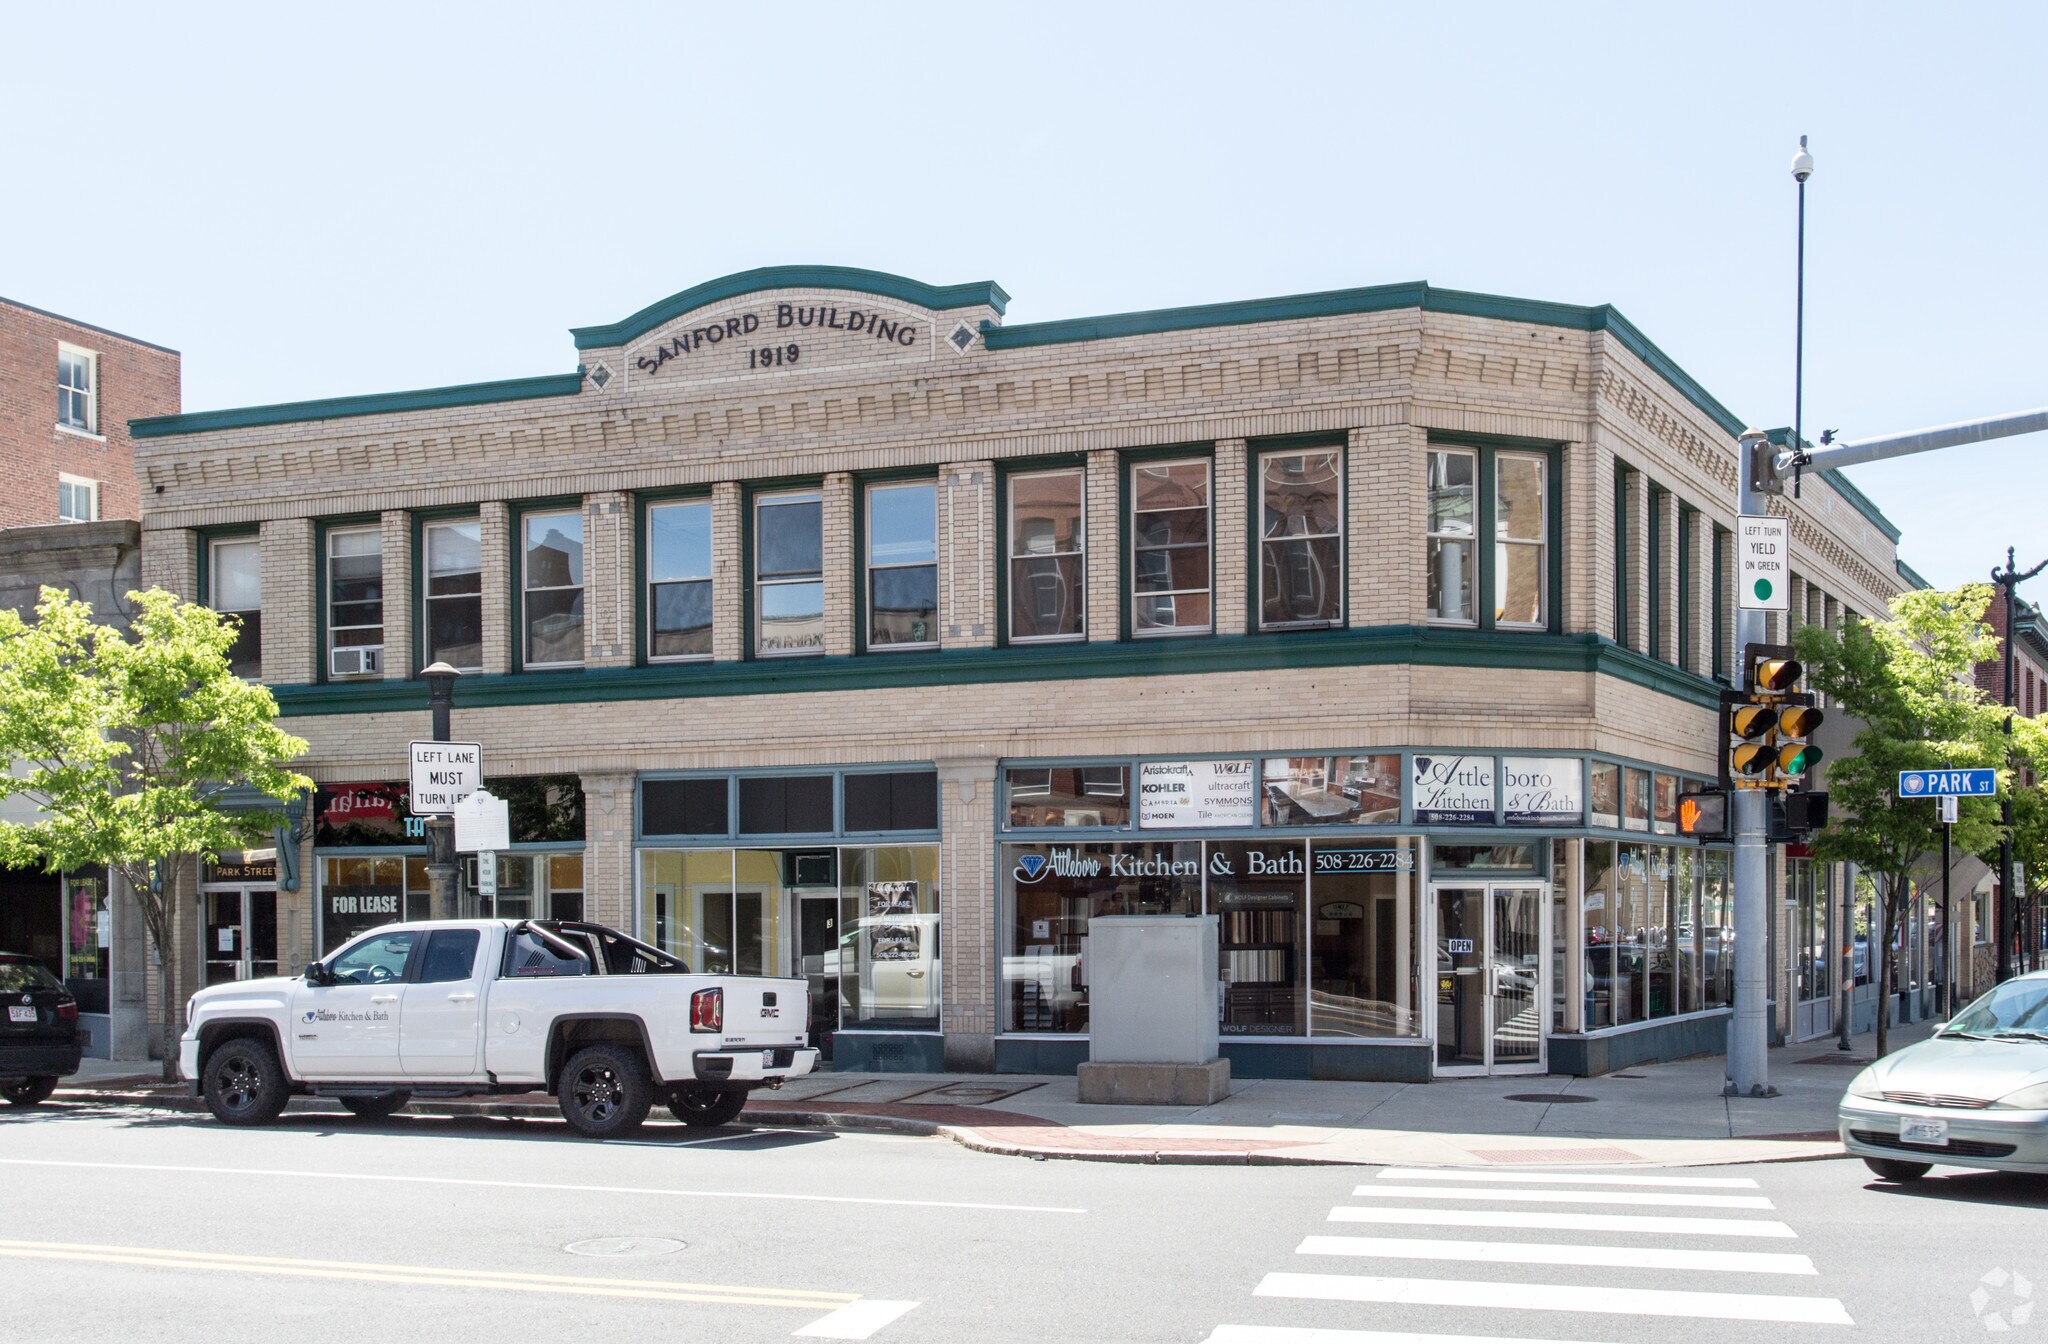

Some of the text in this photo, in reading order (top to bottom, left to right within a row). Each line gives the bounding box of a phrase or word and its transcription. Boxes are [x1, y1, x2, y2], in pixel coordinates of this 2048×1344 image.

[637, 304, 916, 375] SANFORD BUILDING
[749, 343, 799, 369] 1919
[1745, 526, 1782, 536] LEFT TURN
[1751, 542, 1776, 555] YIELD
[1745, 560, 1780, 570] ON GREEN
[417, 751, 475, 763] LEFT LANE
[1142, 764, 1188, 775] Aristokraft
[1213, 762, 1252, 775] WOLF
[430, 771, 463, 785] MUST
[1928, 773, 1990, 792] PARK ST
[1141, 783, 1186, 793] KOHLER
[1208, 780, 1251, 791] ultracraft
[419, 793, 470, 805] TURN LEF
[1204, 796, 1253, 805] SYMMONS
[1418, 786, 1490, 809] Kitchen
[1527, 788, 1574, 812] Bath
[1151, 812, 1175, 820] MOEN
[1197, 810, 1213, 819] Tile
[1431, 813, 1474, 821] 508-226-2284
[404, 816, 425, 837] TA
[1040, 848, 1304, 878] Attleboro Kitchen & Bath
[1315, 853, 1414, 870] 508-226-2284
[216, 866, 240, 877] PARK
[332, 895, 397, 914] FOR LEASE
[1451, 940, 1471, 952] OPEN
[338, 1011, 364, 1021] Kitchen
[364, 1010, 372, 1021] &
[373, 1010, 389, 1021] Bath
[760, 1008, 779, 1018] GMC
[1249, 1025, 1293, 1033] DESIGNER
